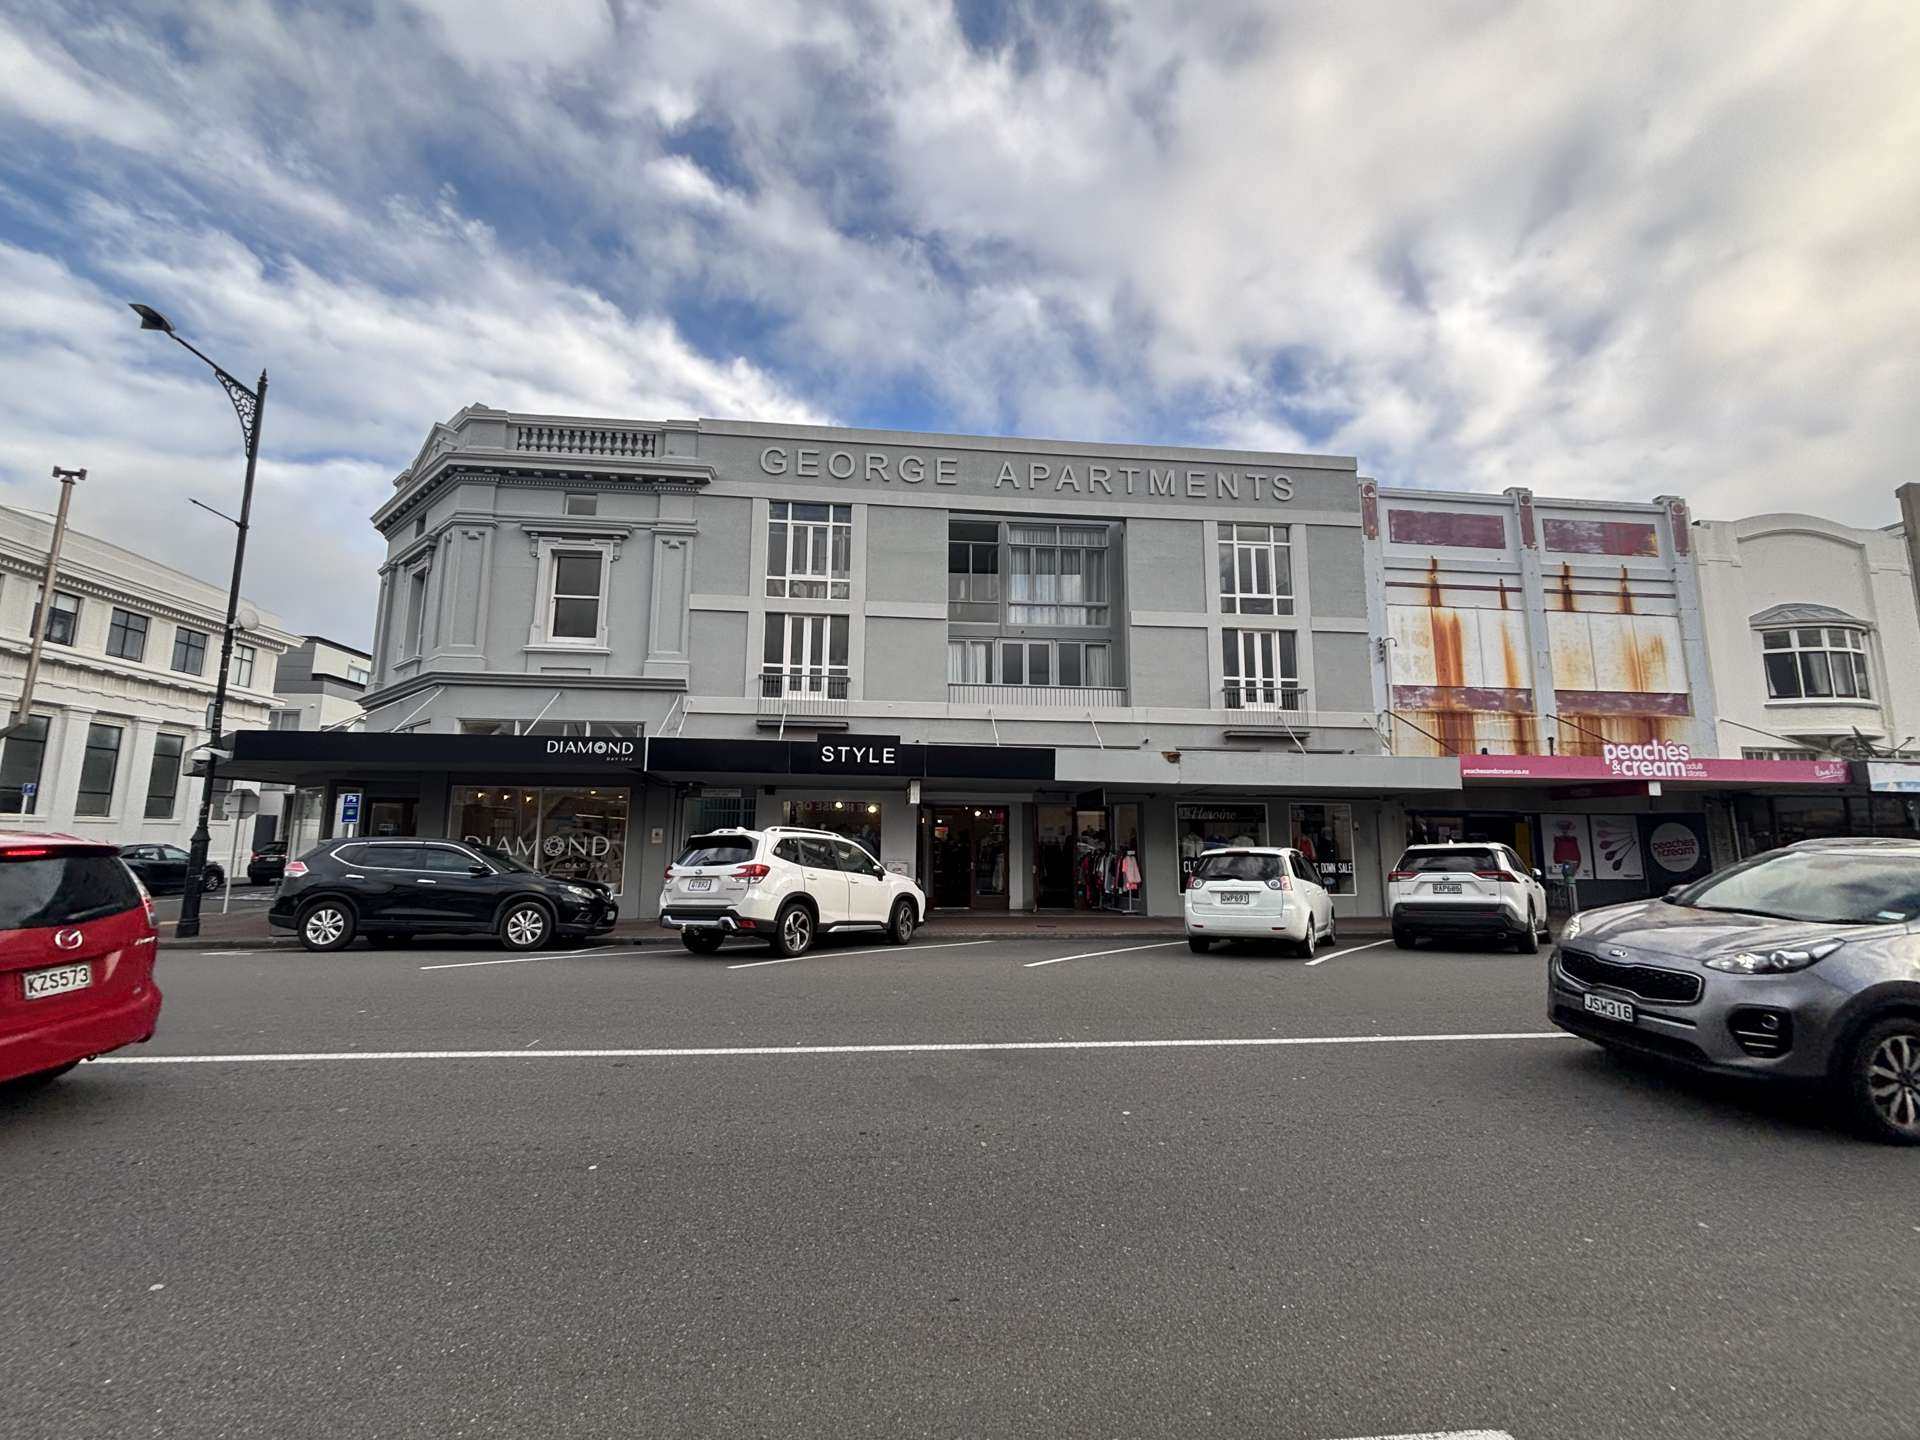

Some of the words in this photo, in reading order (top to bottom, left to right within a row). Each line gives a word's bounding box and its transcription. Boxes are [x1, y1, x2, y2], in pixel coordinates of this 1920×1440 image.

[760, 446, 958, 486] GEORGE
[994, 461, 1295, 502] APARTMENTS
[547, 740, 633, 755] DIAMOND
[821, 746, 895, 764] STYLE
[1621, 761, 1687, 777] cream
[1320, 862, 1336, 874] DOWN
[1338, 862, 1353, 874] SALE
[27, 967, 90, 995] KZS573
[1585, 996, 1632, 1019] JSW316
